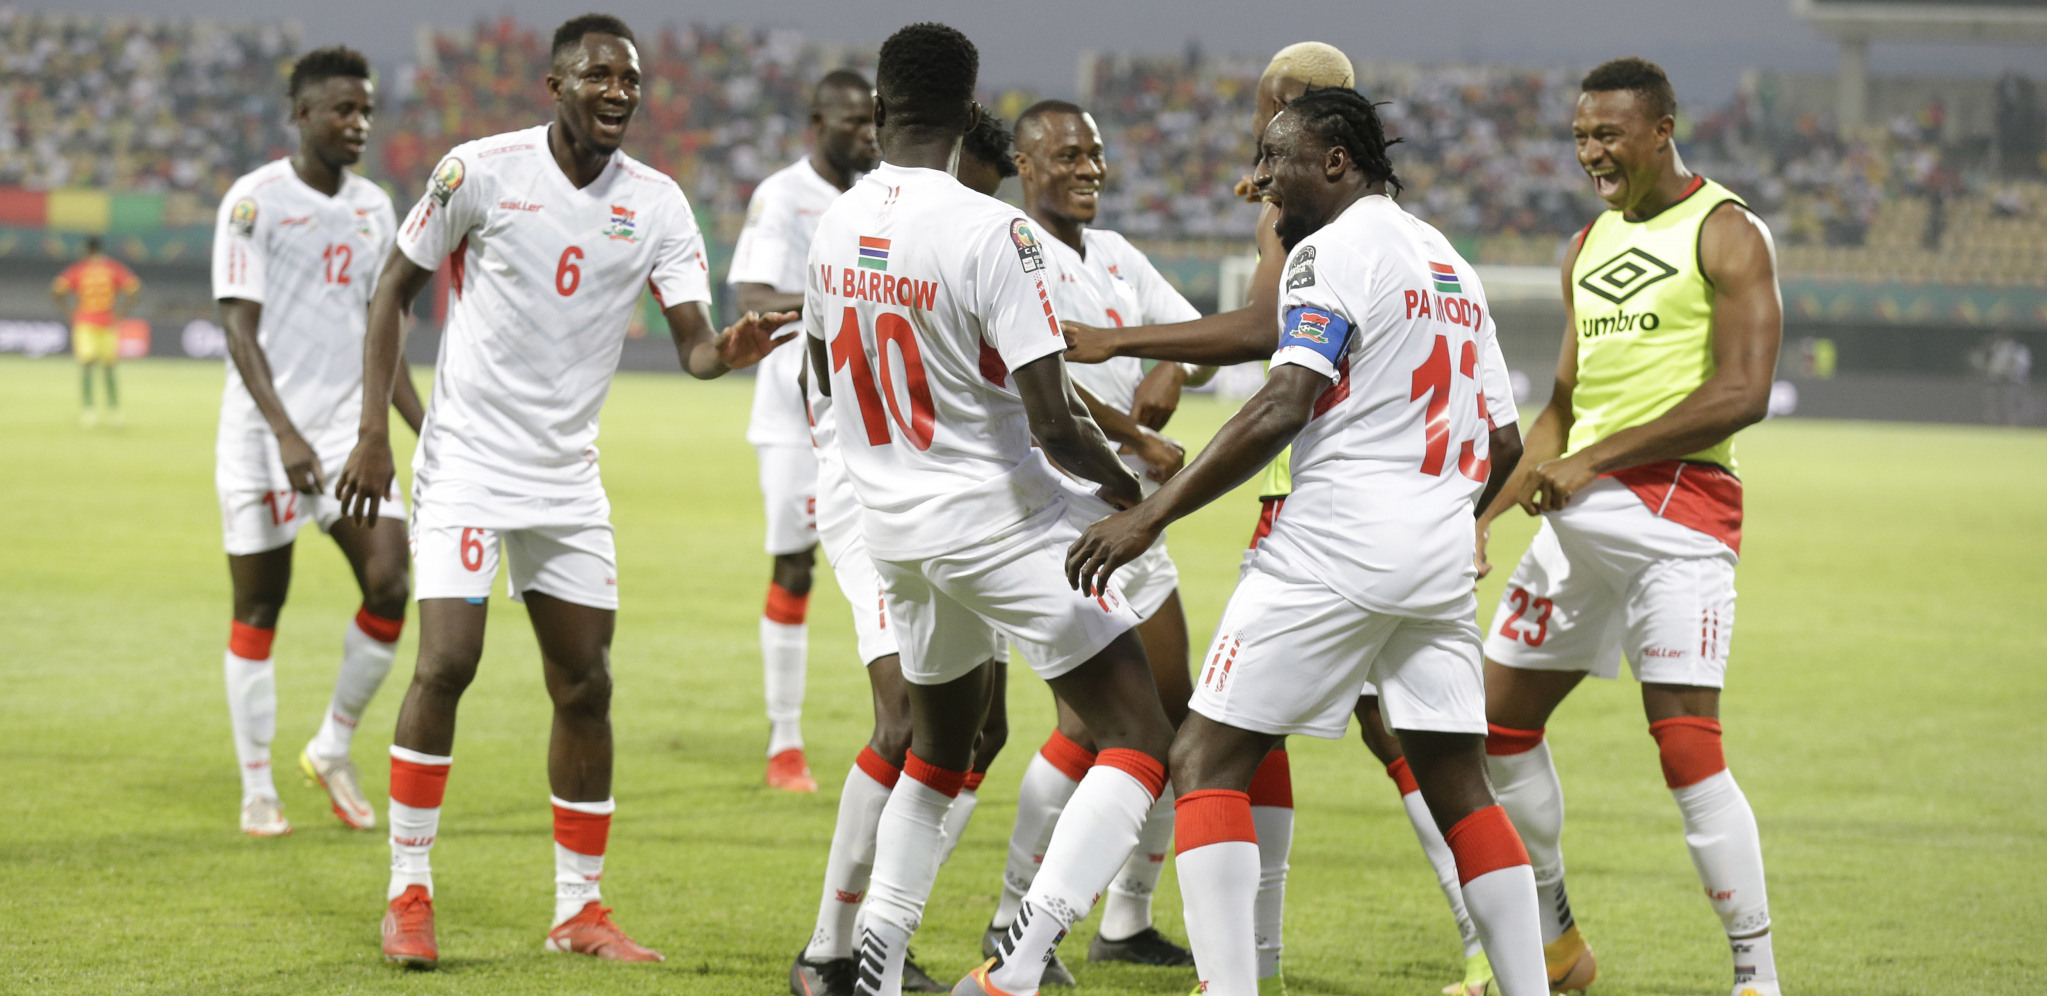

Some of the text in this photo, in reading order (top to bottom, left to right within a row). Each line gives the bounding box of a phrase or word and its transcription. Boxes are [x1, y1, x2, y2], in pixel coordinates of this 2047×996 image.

[323, 243, 353, 285] 12
[556, 245, 584, 297] 6
[821, 264, 938, 311] M. BARROW
[1404, 289, 1485, 333] PA MODO
[1583, 310, 1659, 337] umbro
[830, 306, 936, 451] 10
[1410, 334, 1491, 483] 13
[261, 490, 297, 526] 12
[461, 527, 484, 572] 6
[1499, 587, 1553, 648] 23
